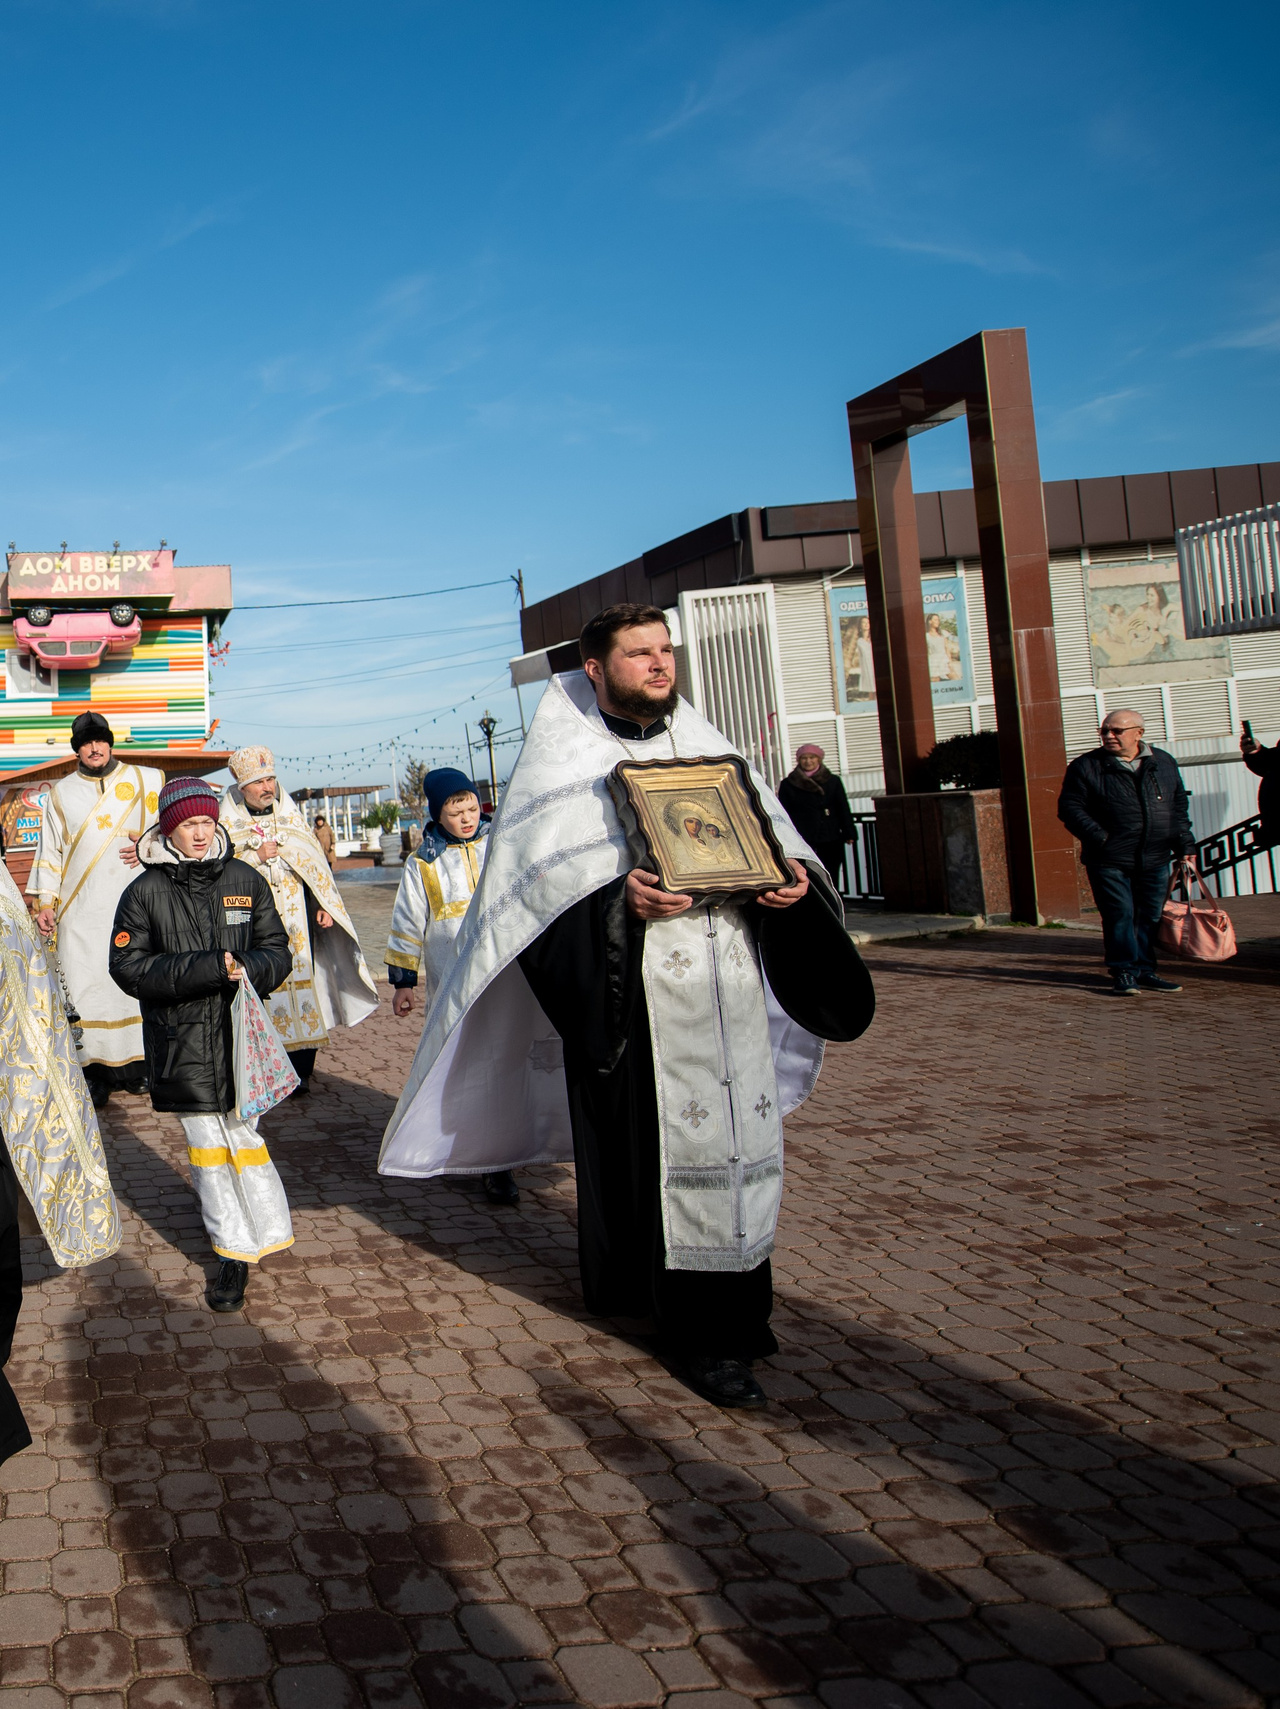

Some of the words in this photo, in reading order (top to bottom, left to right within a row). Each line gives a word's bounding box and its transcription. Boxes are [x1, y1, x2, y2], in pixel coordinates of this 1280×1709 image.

[19, 556, 72, 576] ДОМ
[79, 554, 153, 573] ВВЕРХ
[51, 573, 120, 594] ДНОМ
[940, 686, 964, 694] СЕМЬИ
[16, 817, 40, 829] МЫ
[226, 897, 250, 906] NASA
